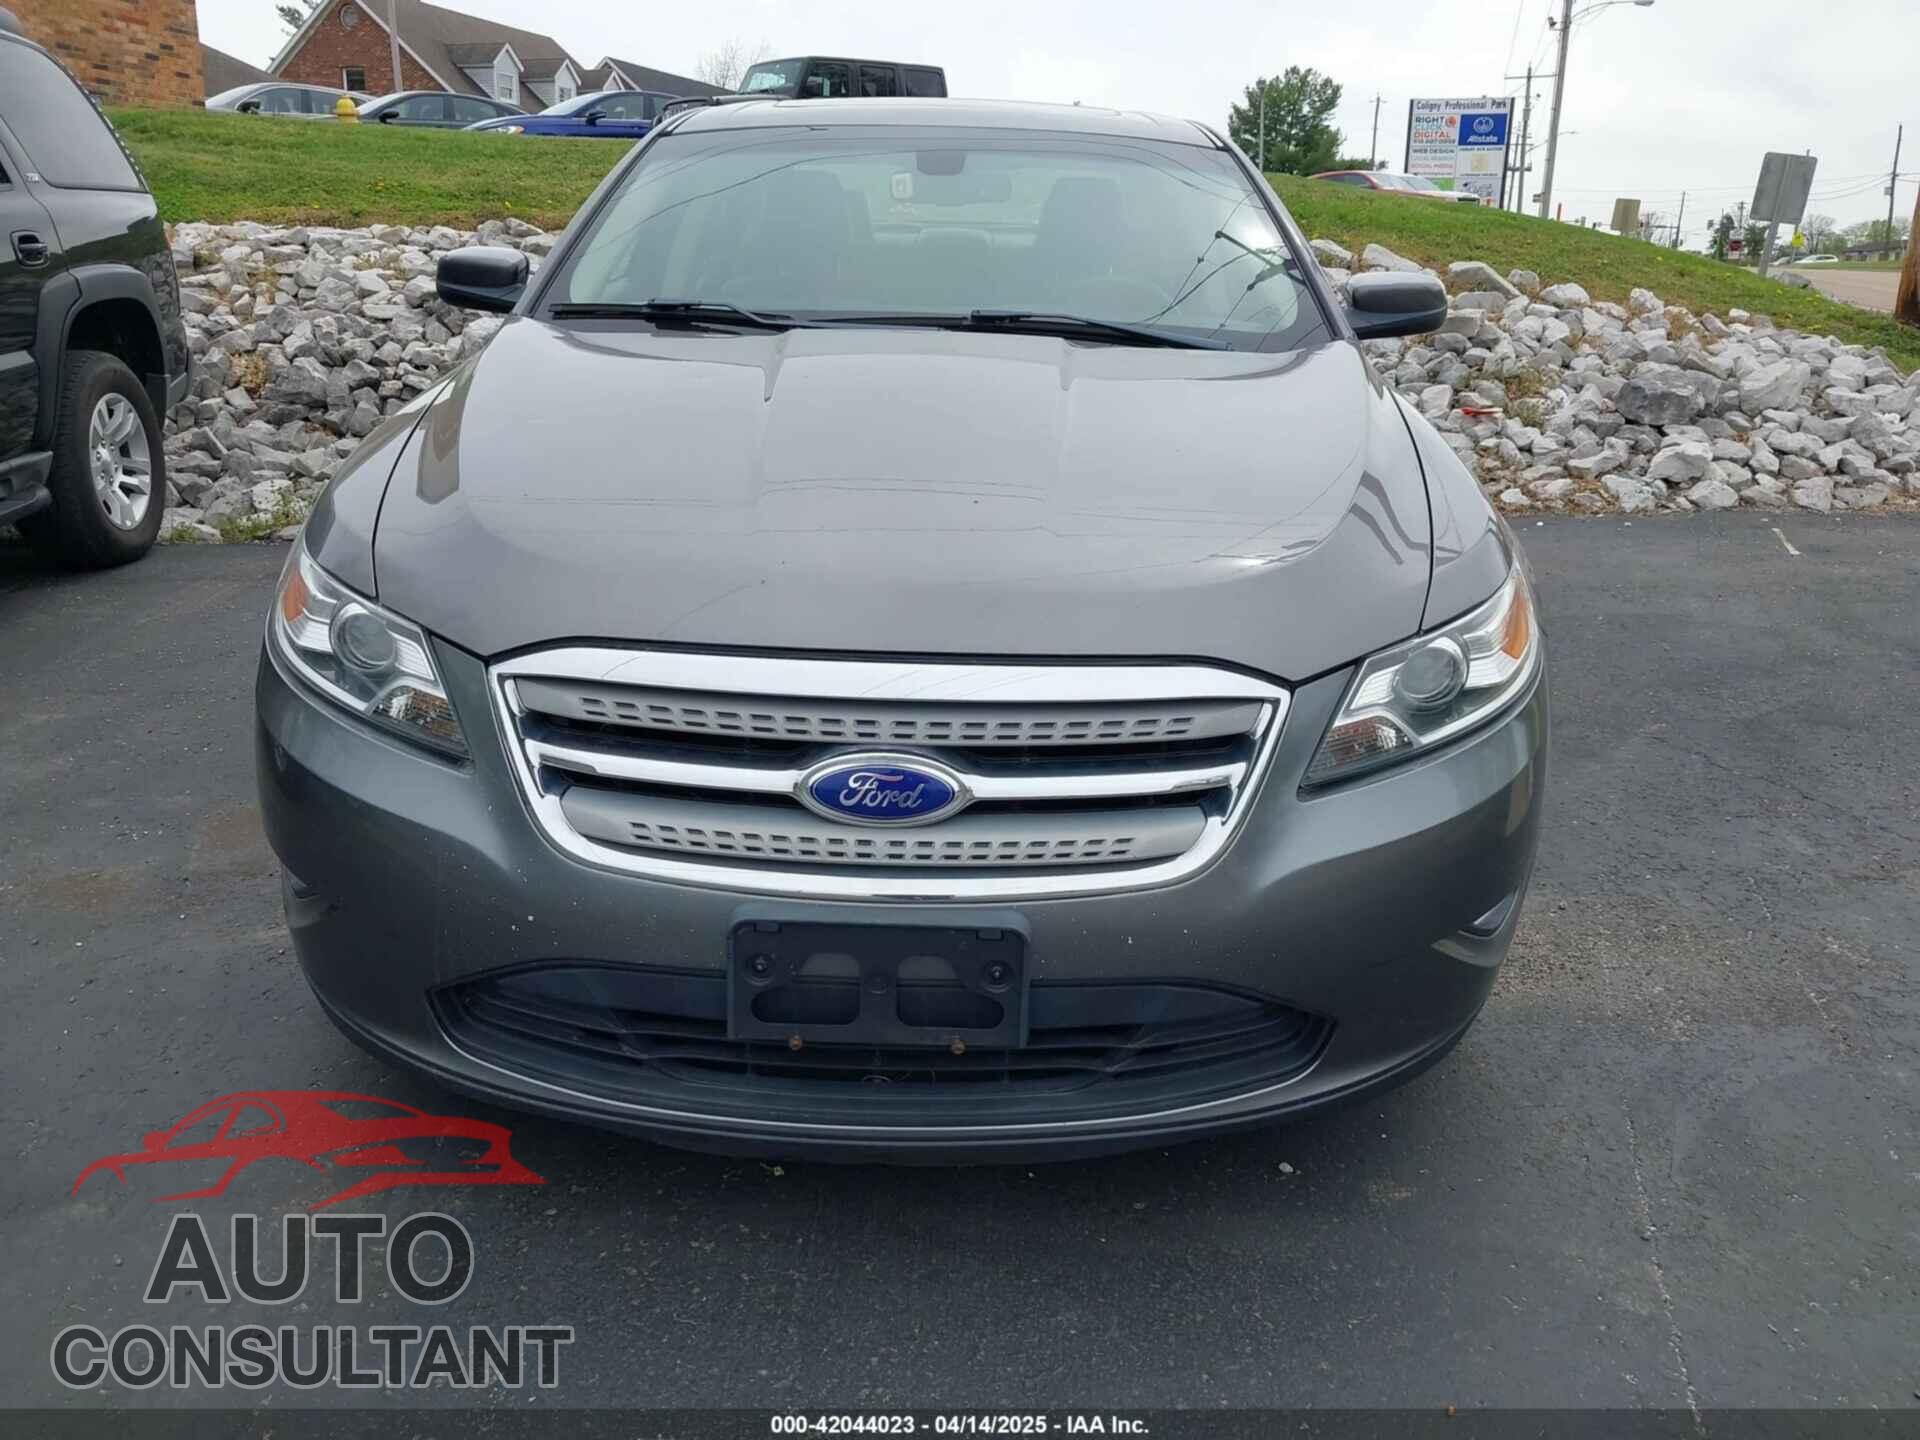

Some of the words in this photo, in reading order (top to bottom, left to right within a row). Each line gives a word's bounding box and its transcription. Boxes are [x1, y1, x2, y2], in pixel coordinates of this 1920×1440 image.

[1416, 101, 1441, 112] Coligny
[1445, 100, 1487, 111] Professional
[1491, 99, 1507, 110] Park
[1415, 116, 1444, 124] RIGHT
[1467, 135, 1498, 143] Allstate
[839, 772, 925, 808] Ford
